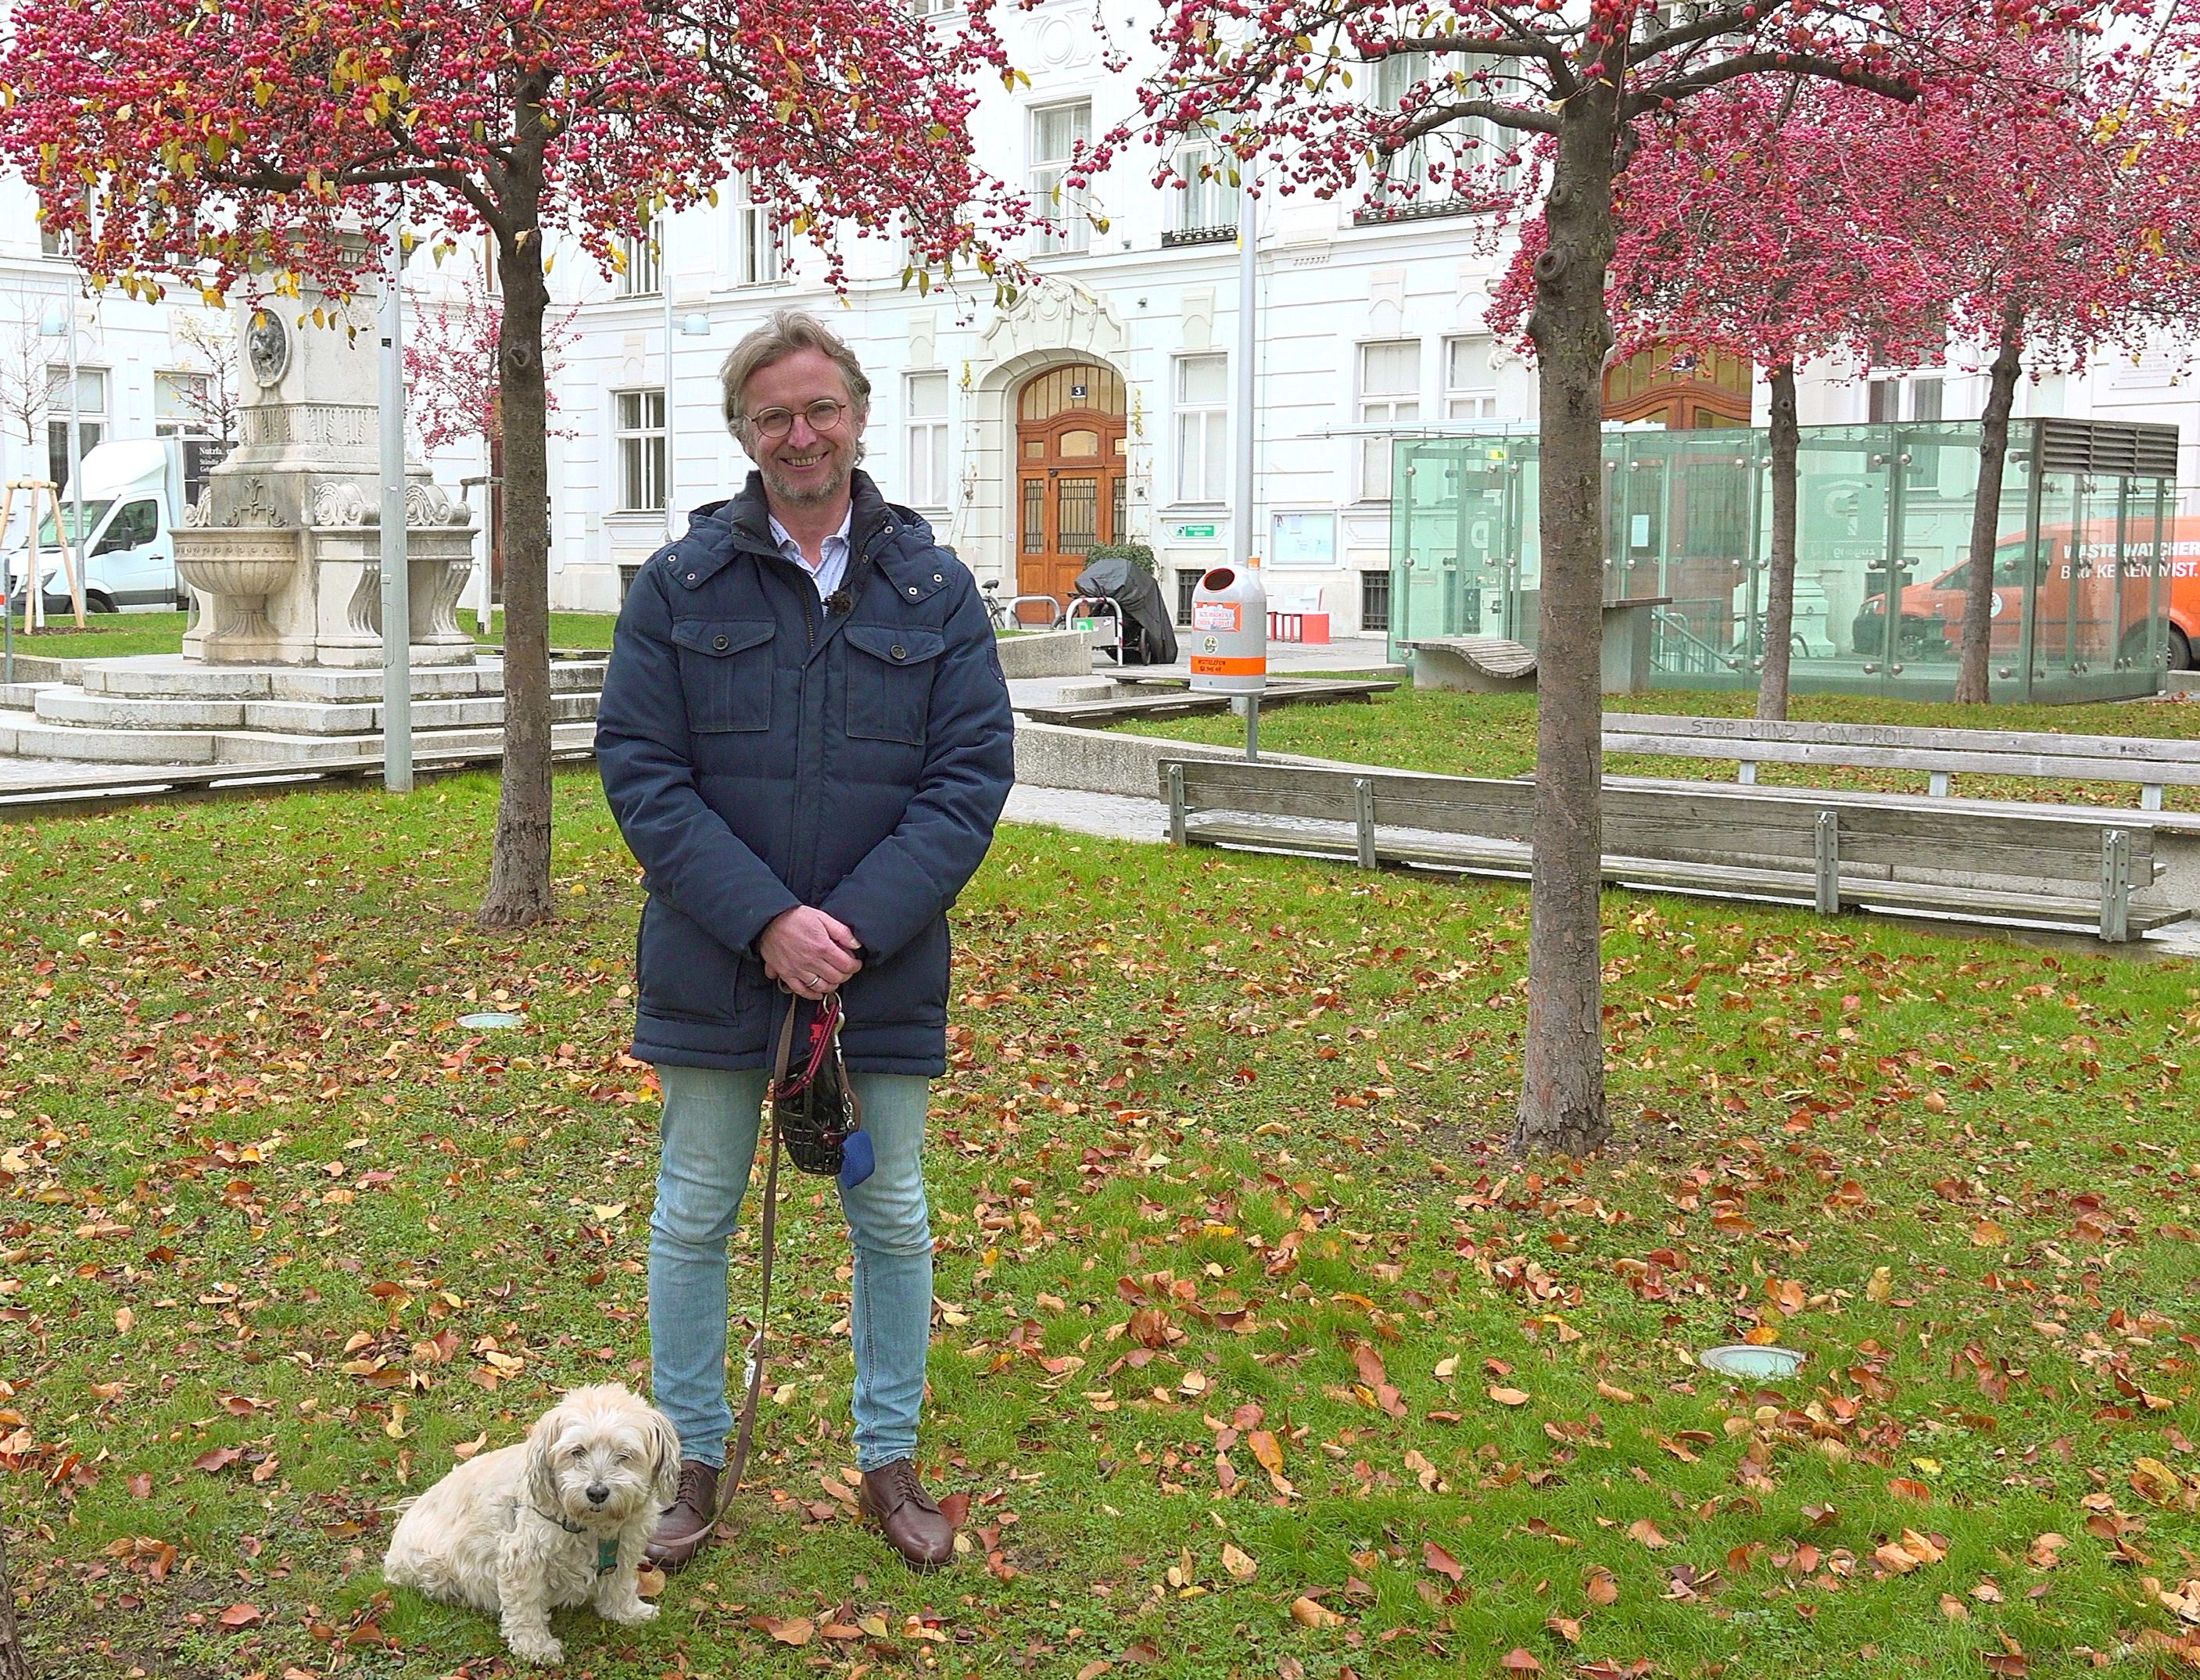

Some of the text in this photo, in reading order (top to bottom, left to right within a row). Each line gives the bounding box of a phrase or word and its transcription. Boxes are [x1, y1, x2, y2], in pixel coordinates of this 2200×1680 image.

[1075, 387, 1081, 396] 3
[2158, 561, 2198, 578] MIST.
[1691, 720, 1911, 743] STOP MIND CONTROL
